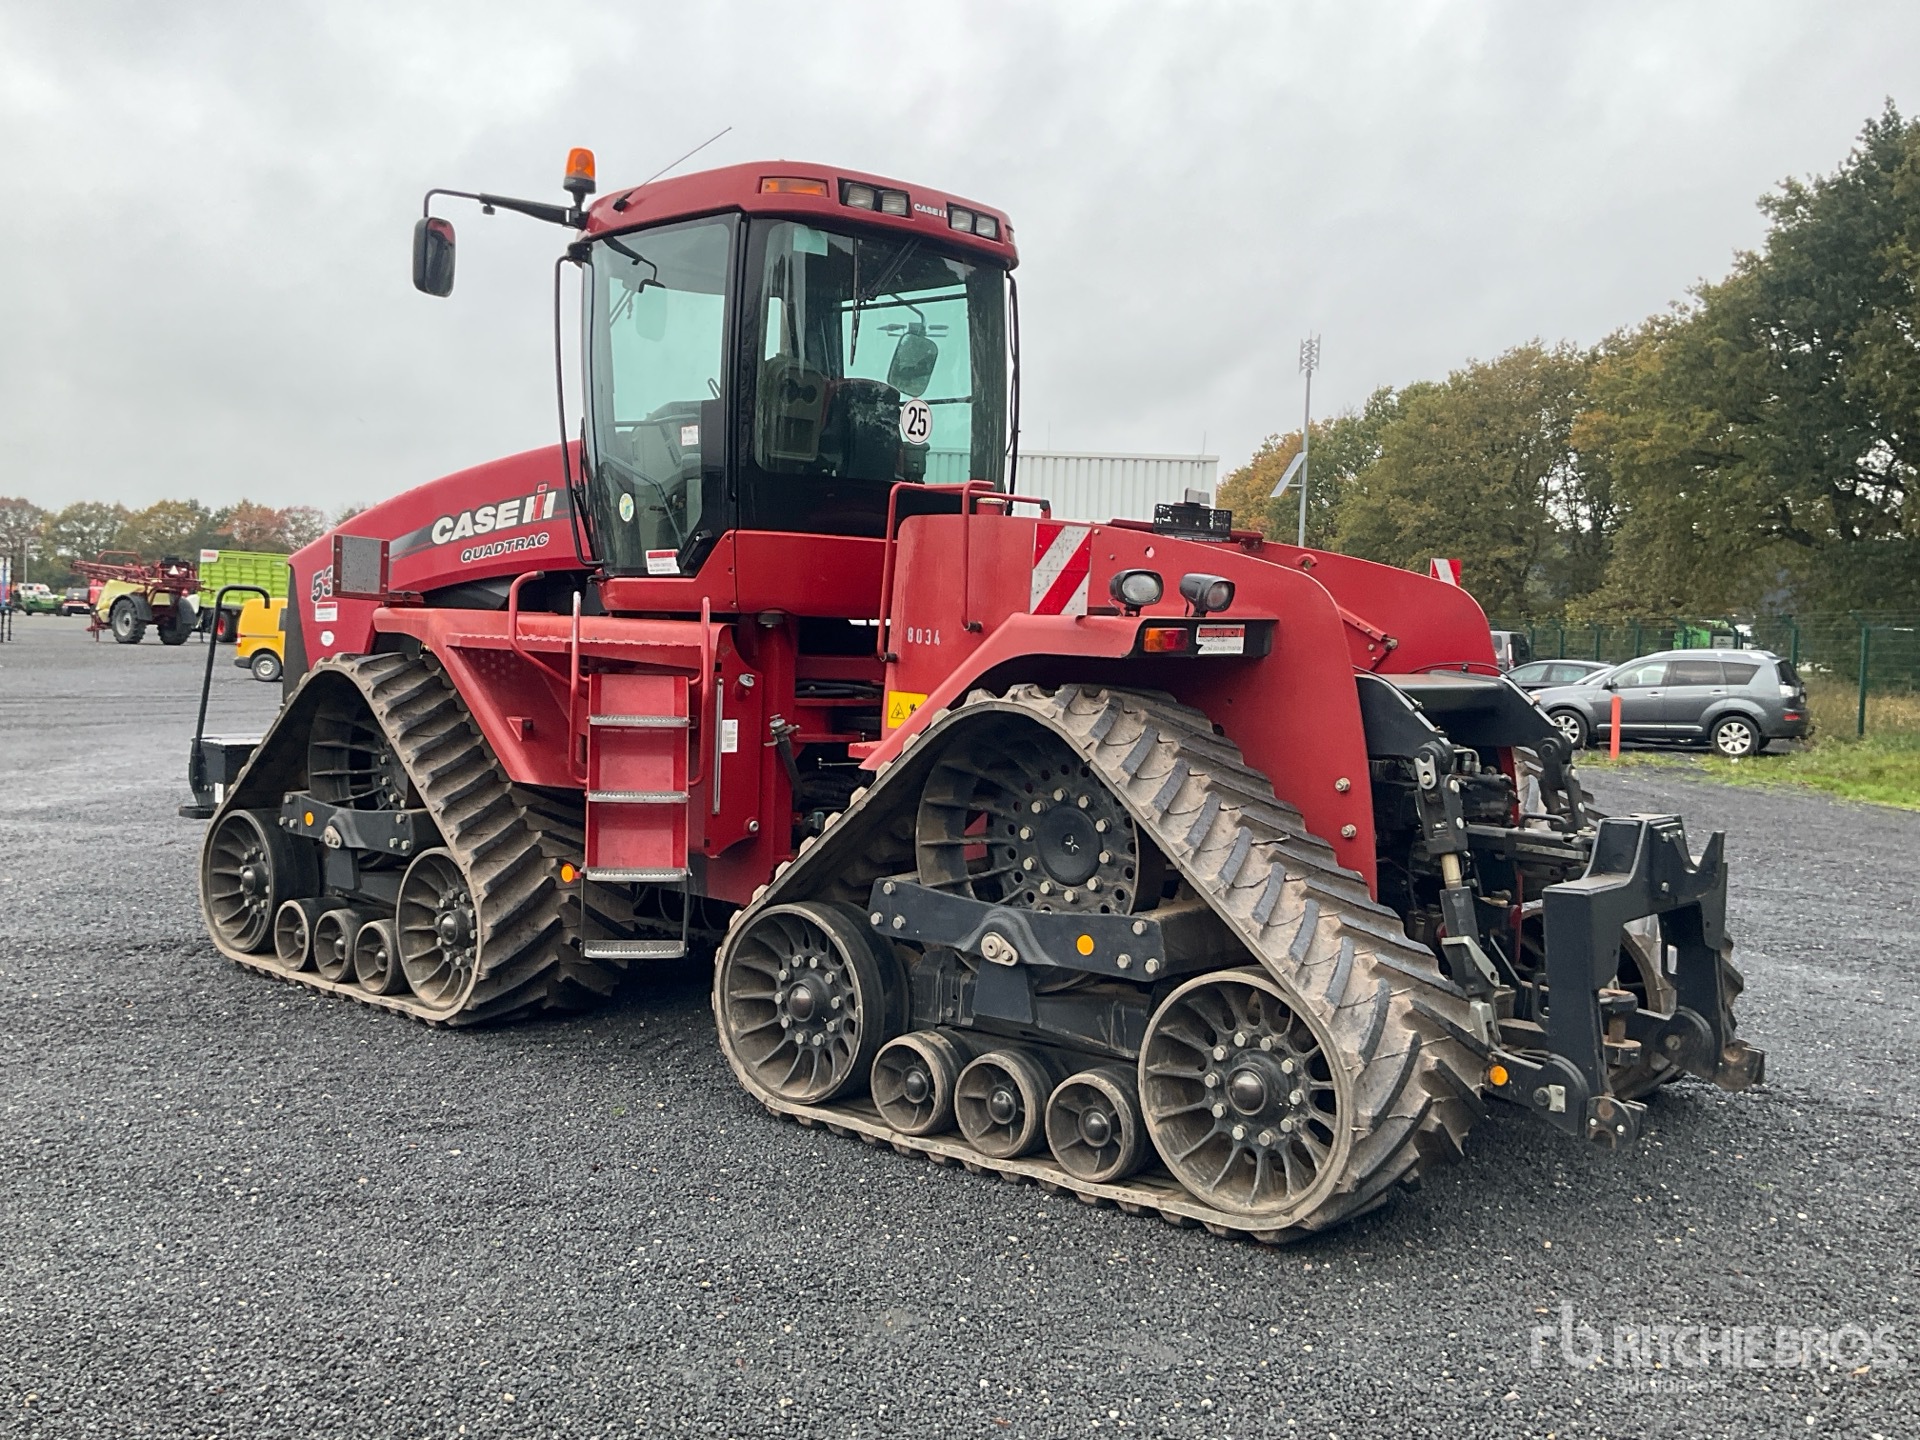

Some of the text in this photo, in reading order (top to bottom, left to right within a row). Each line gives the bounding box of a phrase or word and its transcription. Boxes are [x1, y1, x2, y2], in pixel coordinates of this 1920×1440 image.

[908, 406, 927, 436] 25
[461, 533, 549, 563] QUADTRAC
[907, 626, 941, 646] 8034
